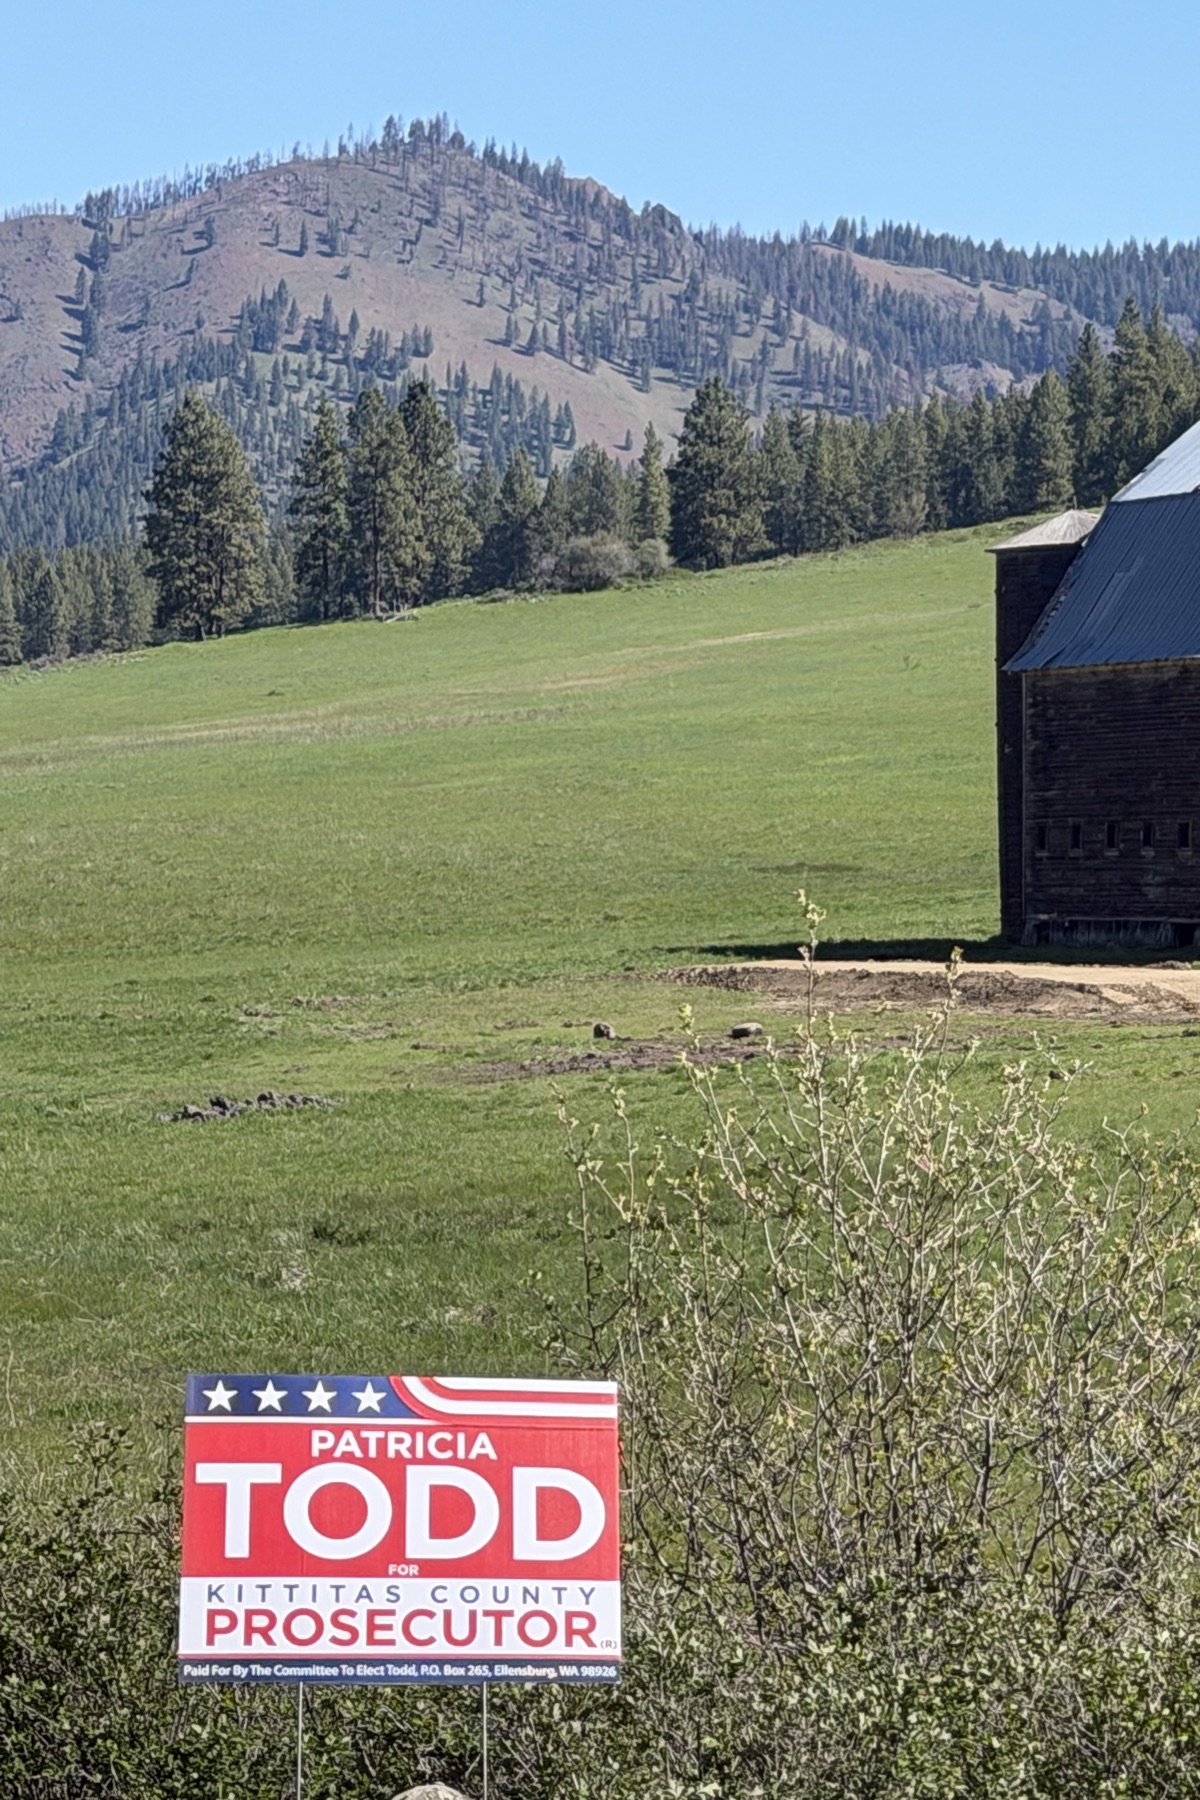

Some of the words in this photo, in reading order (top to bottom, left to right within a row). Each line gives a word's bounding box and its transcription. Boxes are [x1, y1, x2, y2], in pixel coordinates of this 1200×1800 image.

[311, 1430, 498, 1460] PATRICIA
[195, 1462, 606, 1561] TODD
[388, 1564, 419, 1576] FOR
[208, 1583, 402, 1604] KITTITAS
[430, 1584, 596, 1605] COUNTY
[205, 1608, 598, 1648] PROSECUTOR
[600, 1639, 617, 1650] (R)
[183, 1664, 210, 1676] Paid
[211, 1664, 231, 1676] For
[233, 1665, 249, 1678] By
[249, 1664, 272, 1676] The
[273, 1664, 339, 1676] Committee
[340, 1664, 355, 1676] To
[356, 1664, 385, 1676] Elect
[386, 1664, 418, 1677] Todd,
[420, 1664, 441, 1676] P.O.
[443, 1664, 466, 1676] Box
[467, 1665, 492, 1677] 265,
[494, 1664, 558, 1679] Ellensburg,
[559, 1665, 580, 1677] WA
[581, 1665, 617, 1677] 98926
